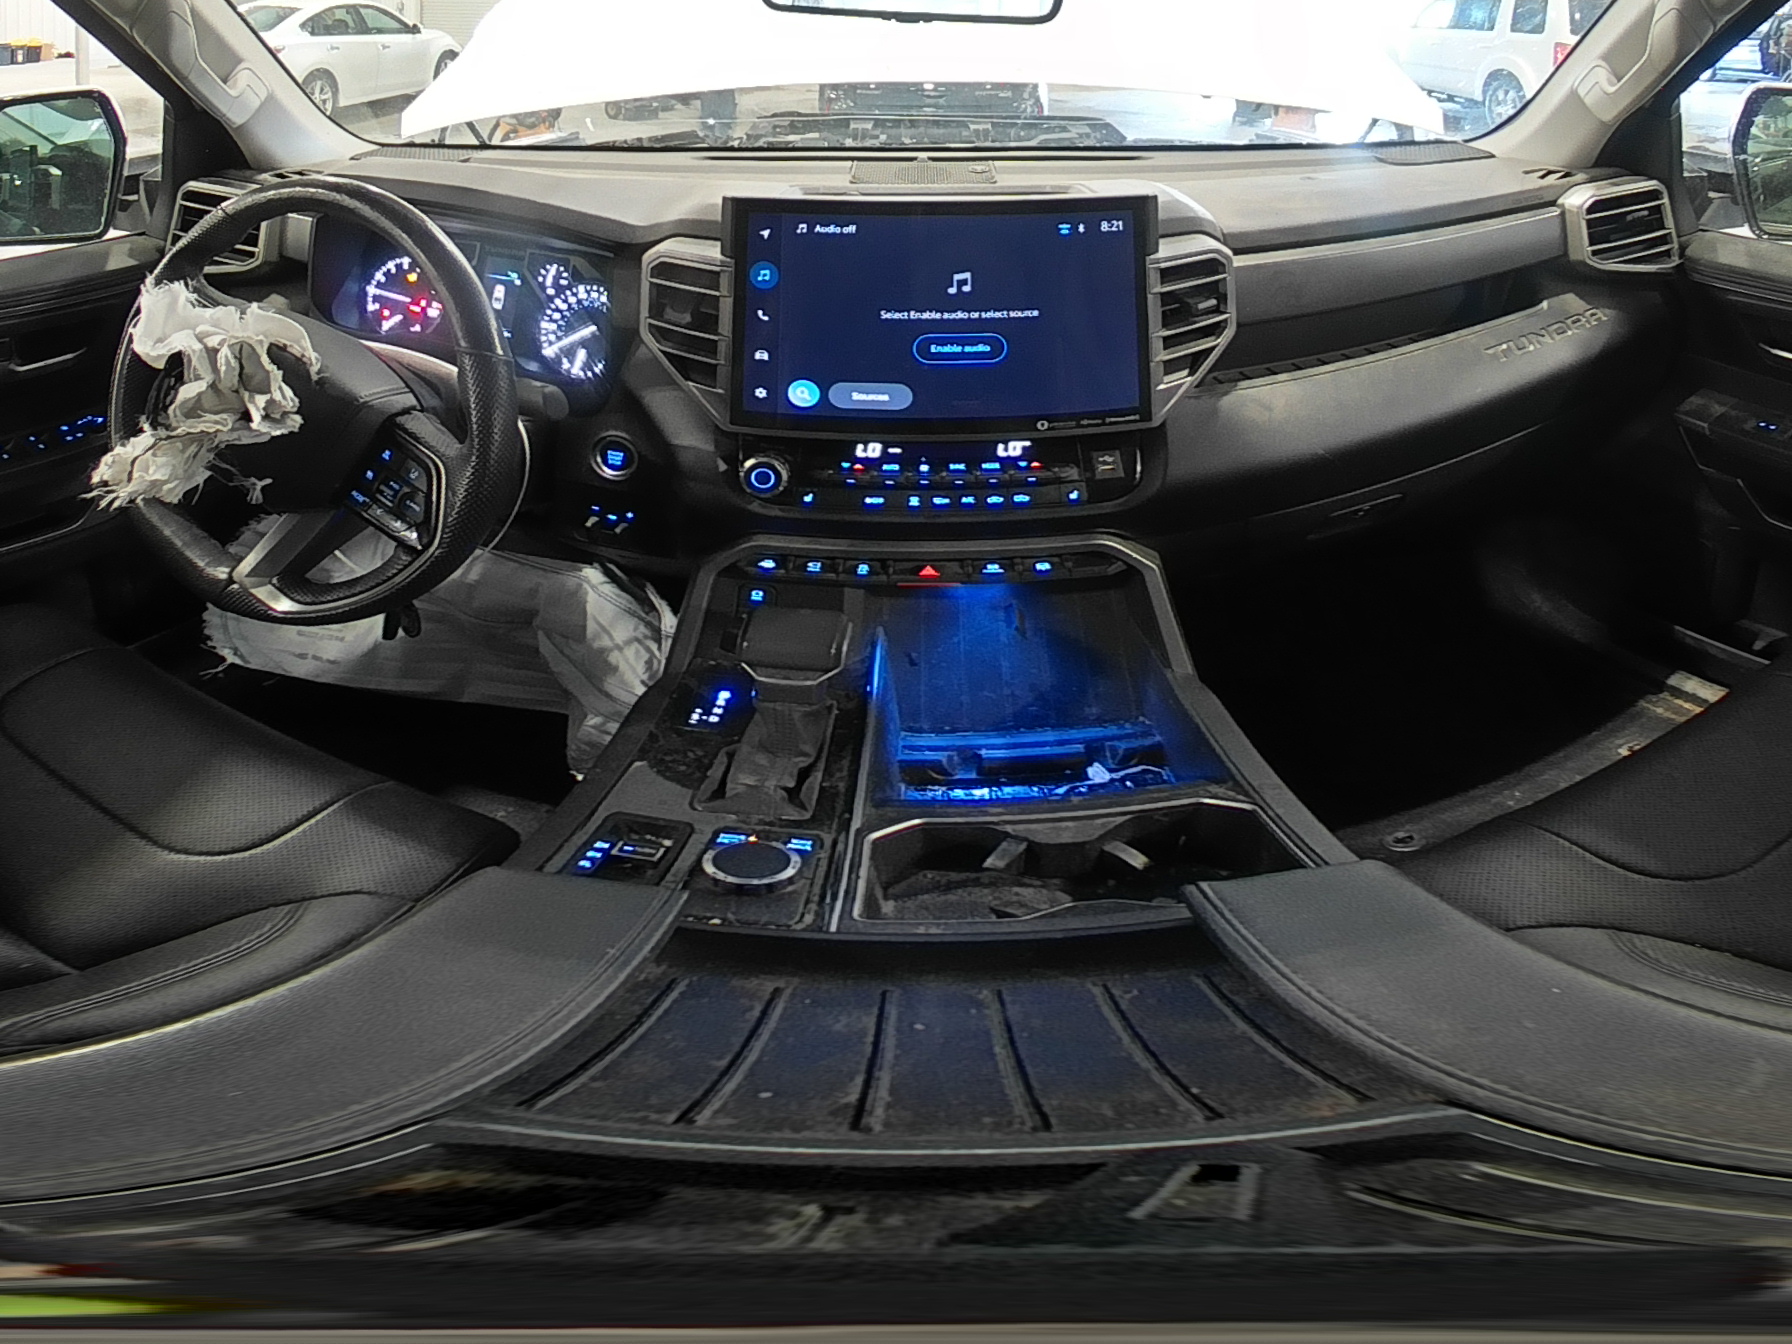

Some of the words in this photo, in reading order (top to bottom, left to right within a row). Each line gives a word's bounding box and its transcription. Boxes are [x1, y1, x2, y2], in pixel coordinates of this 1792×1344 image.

[814, 224, 841, 234] Audio
[842, 224, 857, 235] off
[1100, 219, 1124, 233] 8:21
[880, 309, 908, 320] Select
[910, 309, 942, 320] Enable
[942, 309, 969, 320] audio
[969, 311, 980, 319] or
[981, 309, 1008, 319] select
[1009, 309, 1039, 318] source
[1483, 306, 1609, 363] TUNDRA
[930, 343, 962, 353] Enable
[963, 343, 991, 353] audio
[850, 391, 890, 402] Sources
